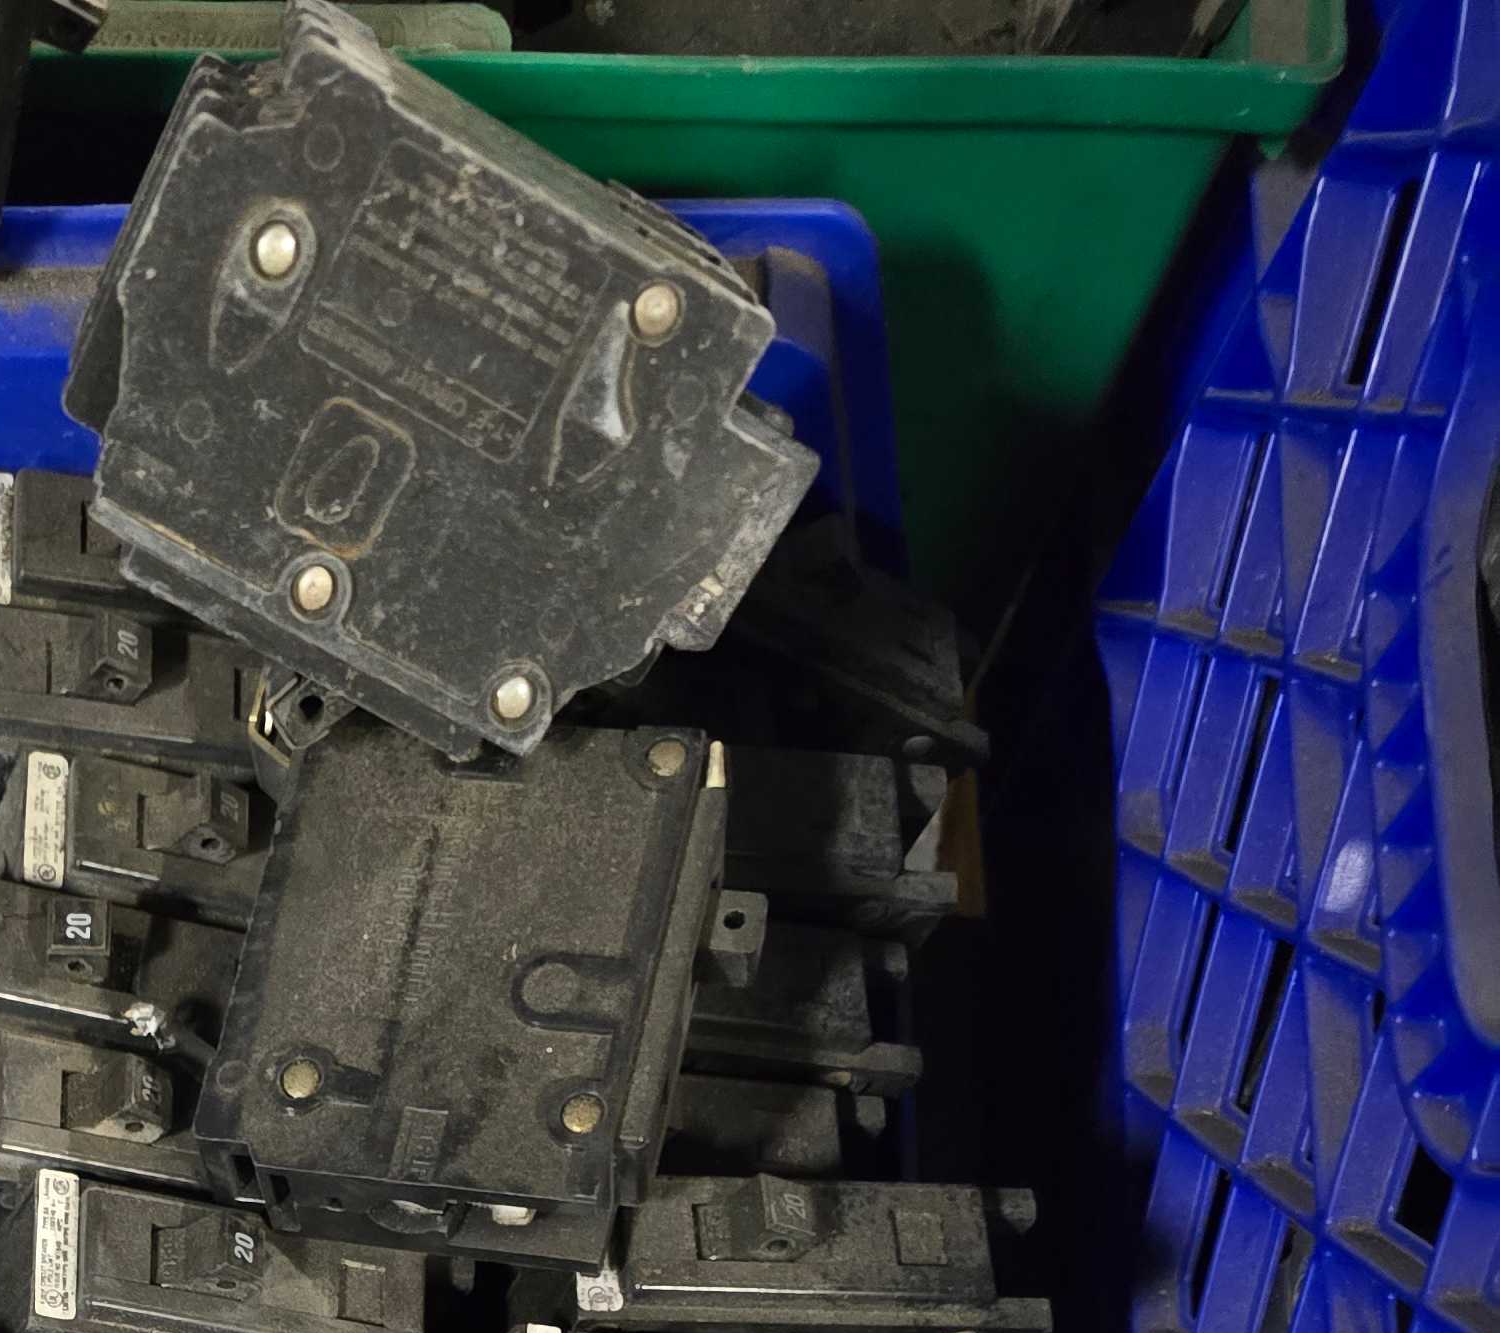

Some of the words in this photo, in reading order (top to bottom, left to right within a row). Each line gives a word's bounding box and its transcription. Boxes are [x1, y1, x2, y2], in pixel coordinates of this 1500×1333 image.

[117, 630, 138, 660] 20
[67, 913, 91, 940] 20
[784, 1194, 807, 1217] 20
[233, 1232, 254, 1264] 20
